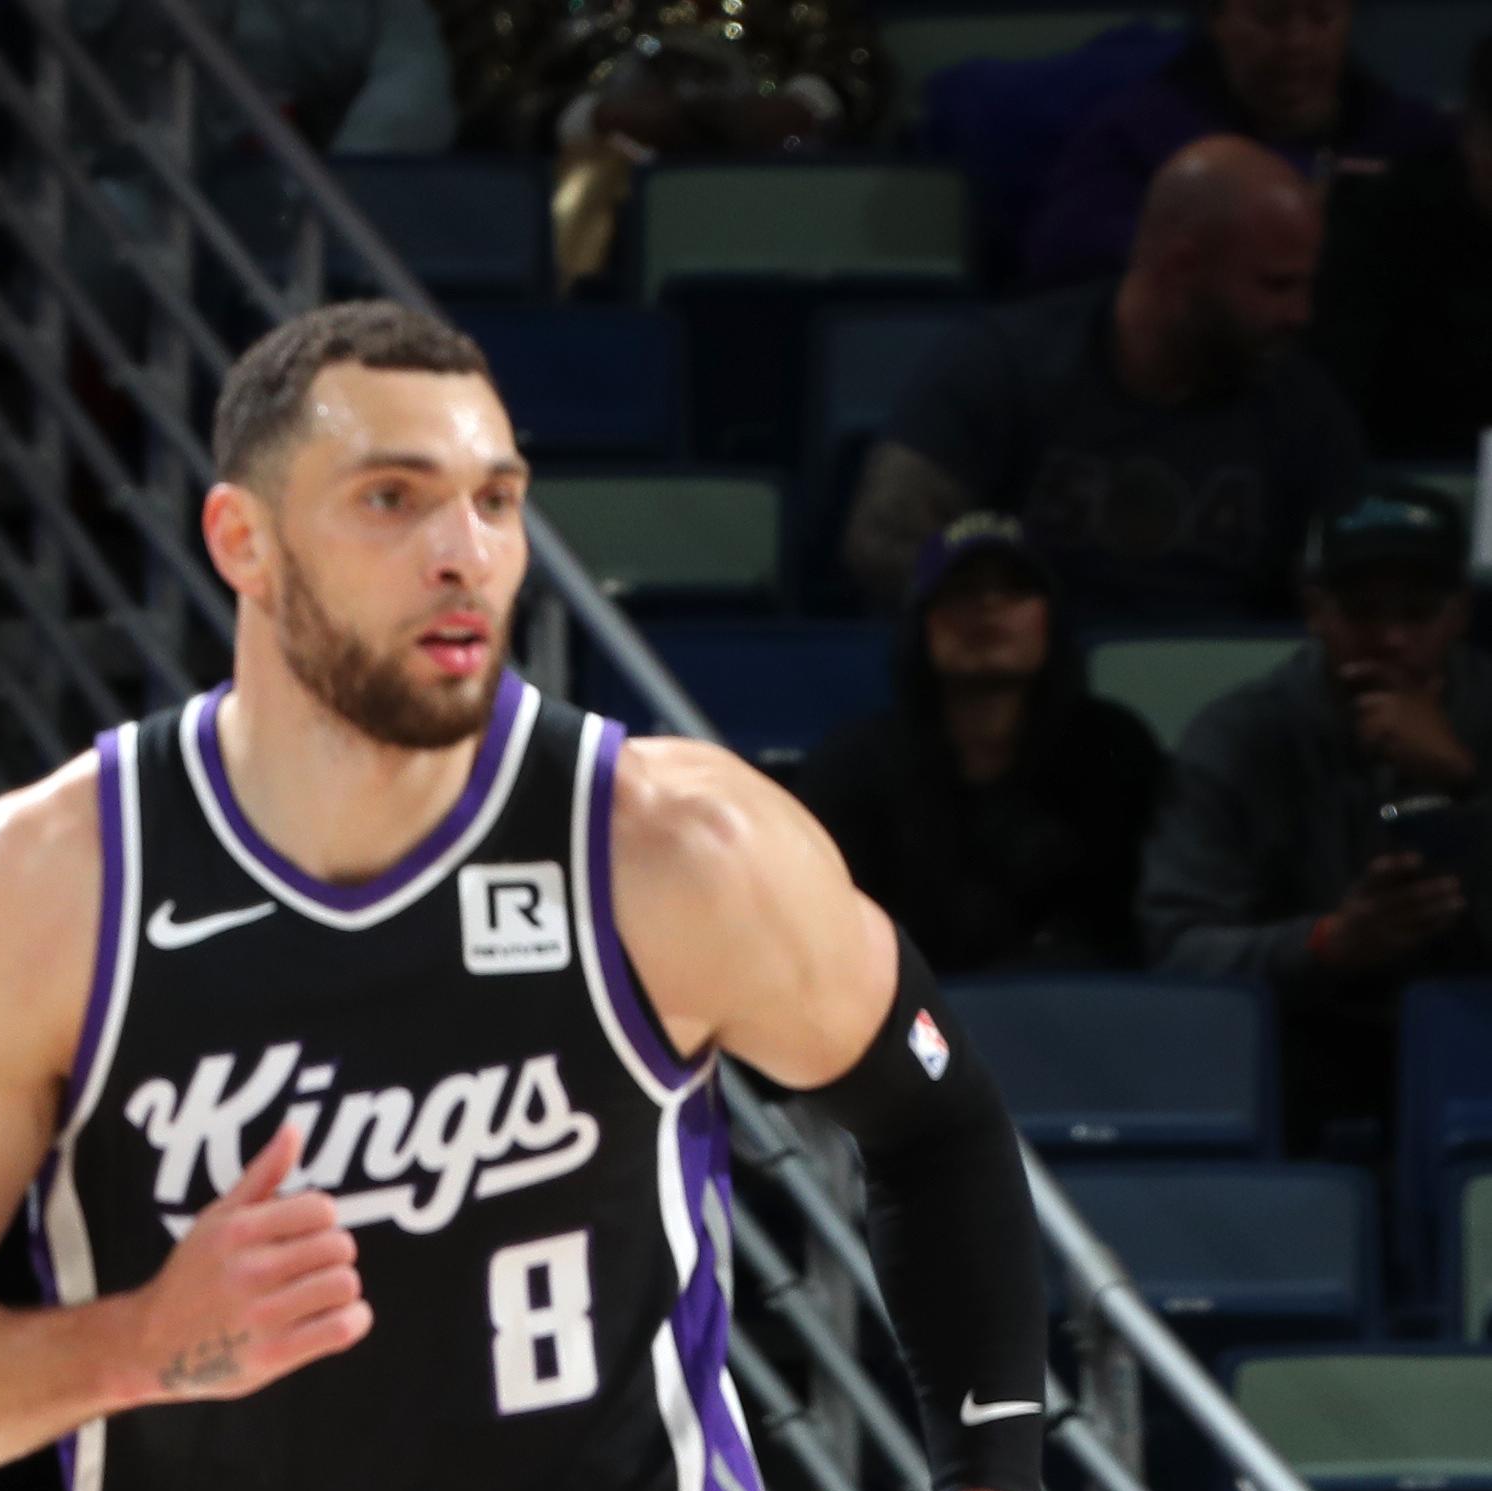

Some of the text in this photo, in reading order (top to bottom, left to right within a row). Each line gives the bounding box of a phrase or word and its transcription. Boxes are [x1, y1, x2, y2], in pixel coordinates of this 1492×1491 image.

[487, 881, 542, 929] R
[124, 1040, 601, 1237] Kings
[487, 1229, 599, 1415] 8
